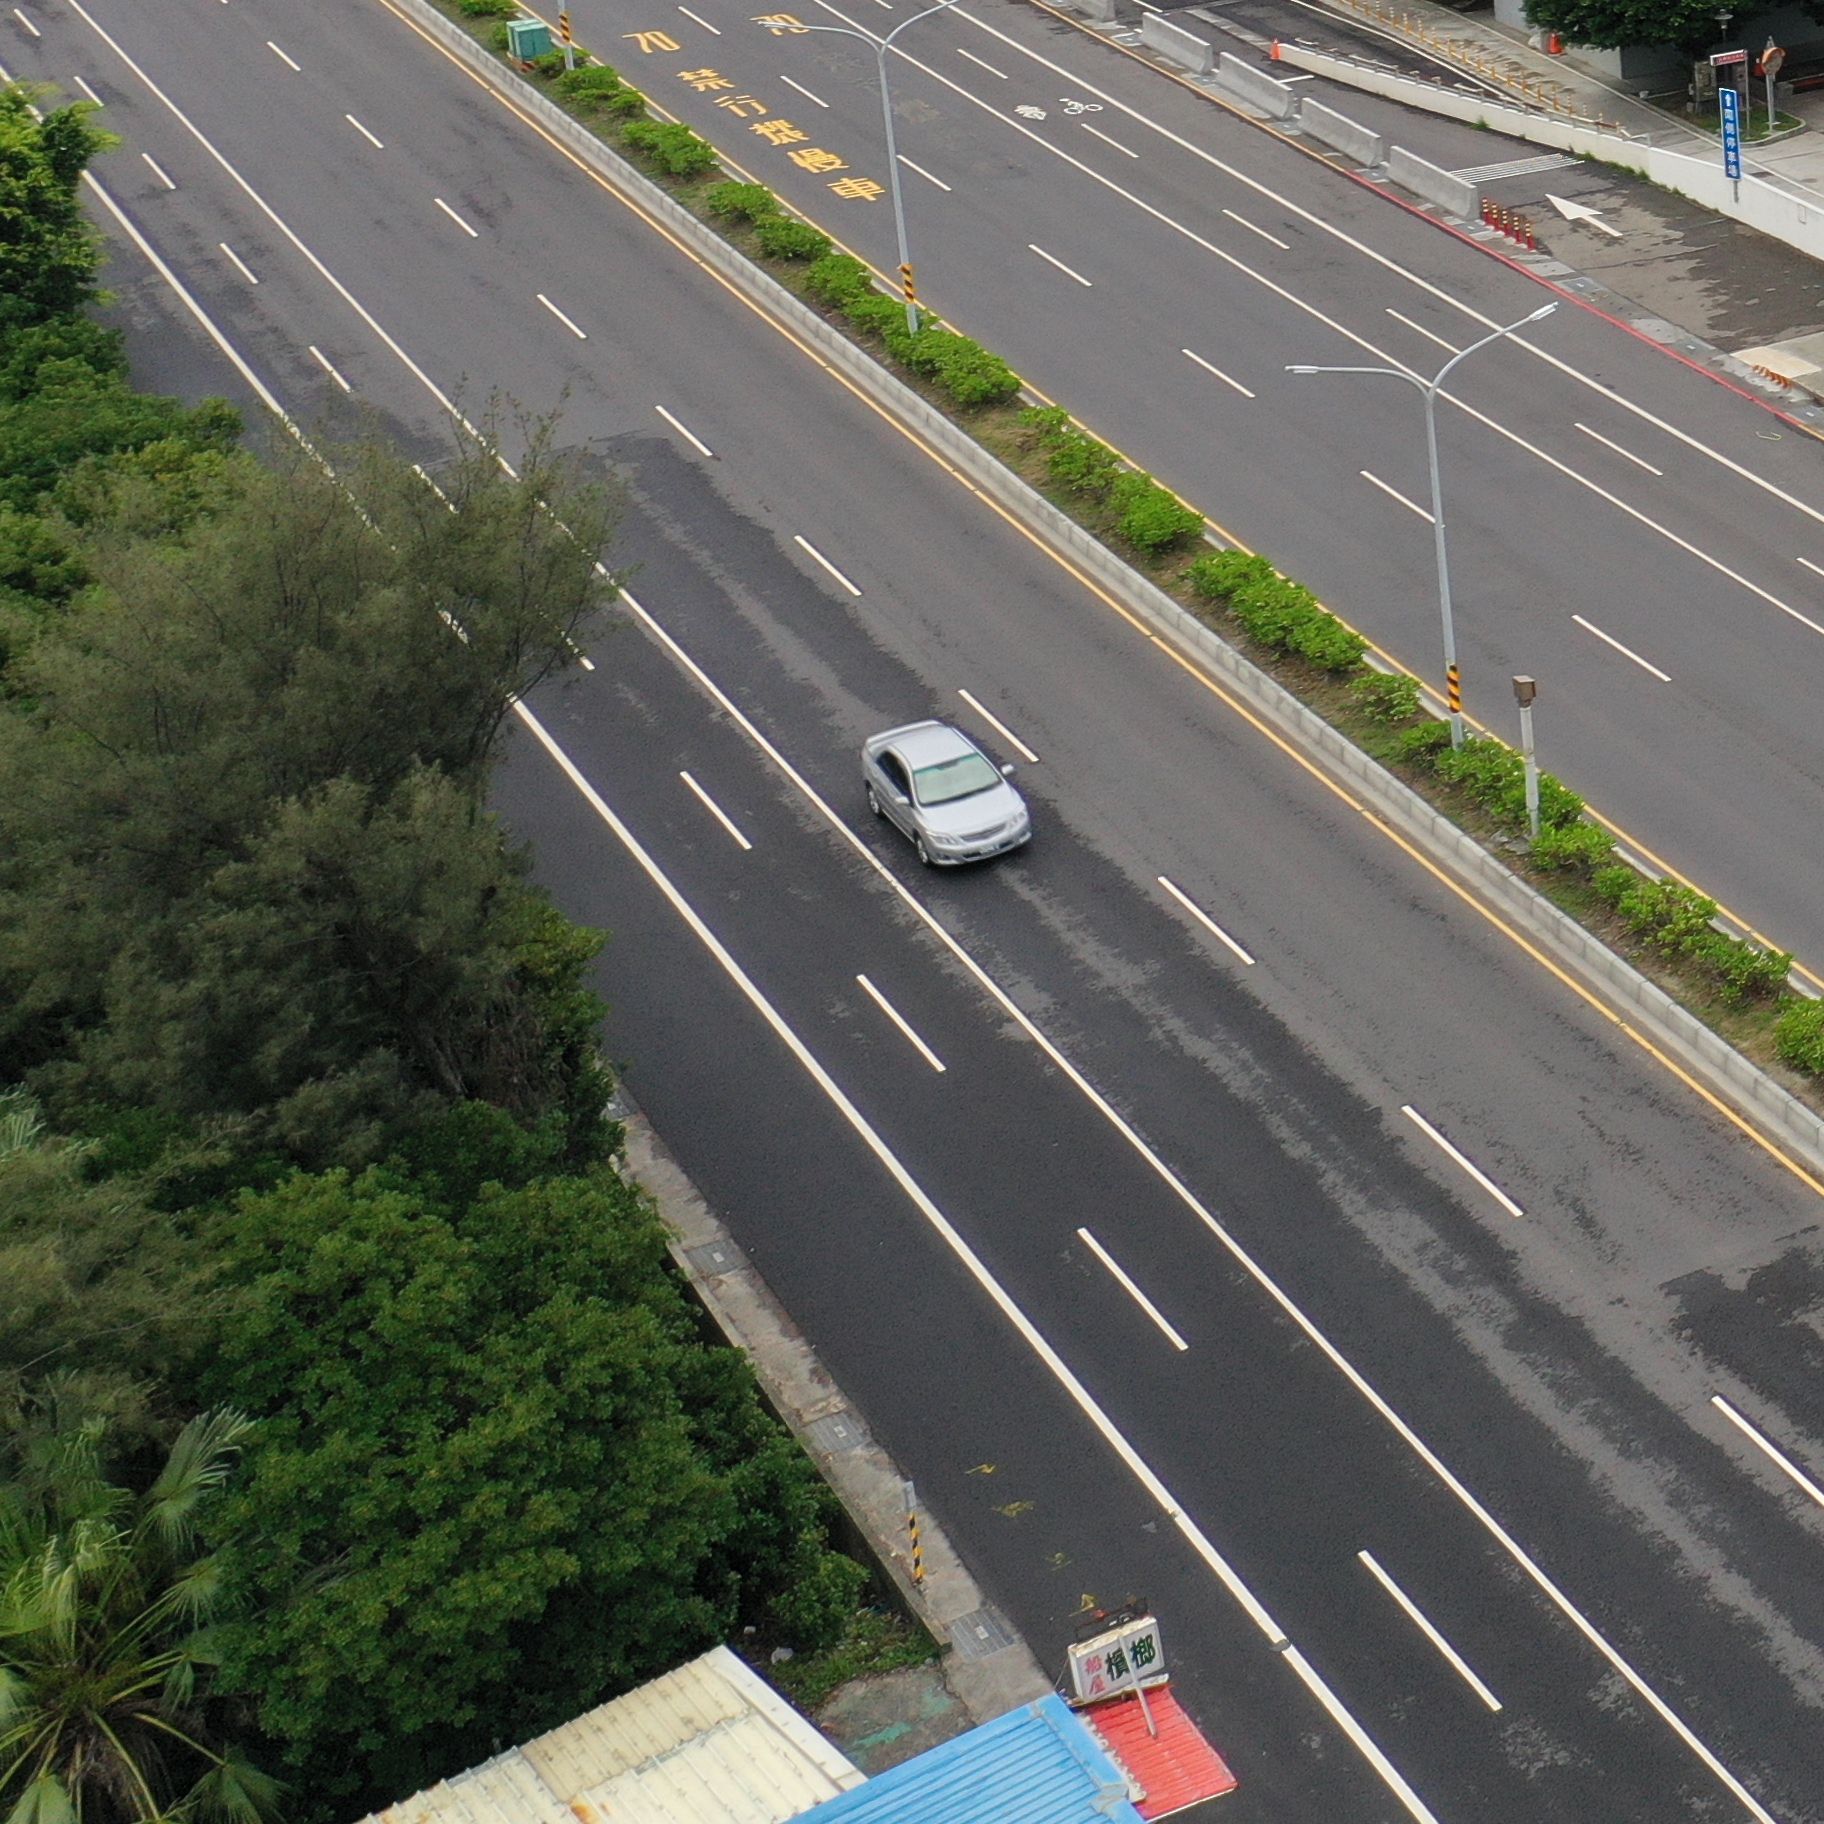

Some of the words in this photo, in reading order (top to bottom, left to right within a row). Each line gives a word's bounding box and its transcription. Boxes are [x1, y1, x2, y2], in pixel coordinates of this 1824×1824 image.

[621, 31, 681, 53] 70
[676, 68, 886, 202] 禁行機慢車
[1104, 1633, 1156, 1682] 檳榔
